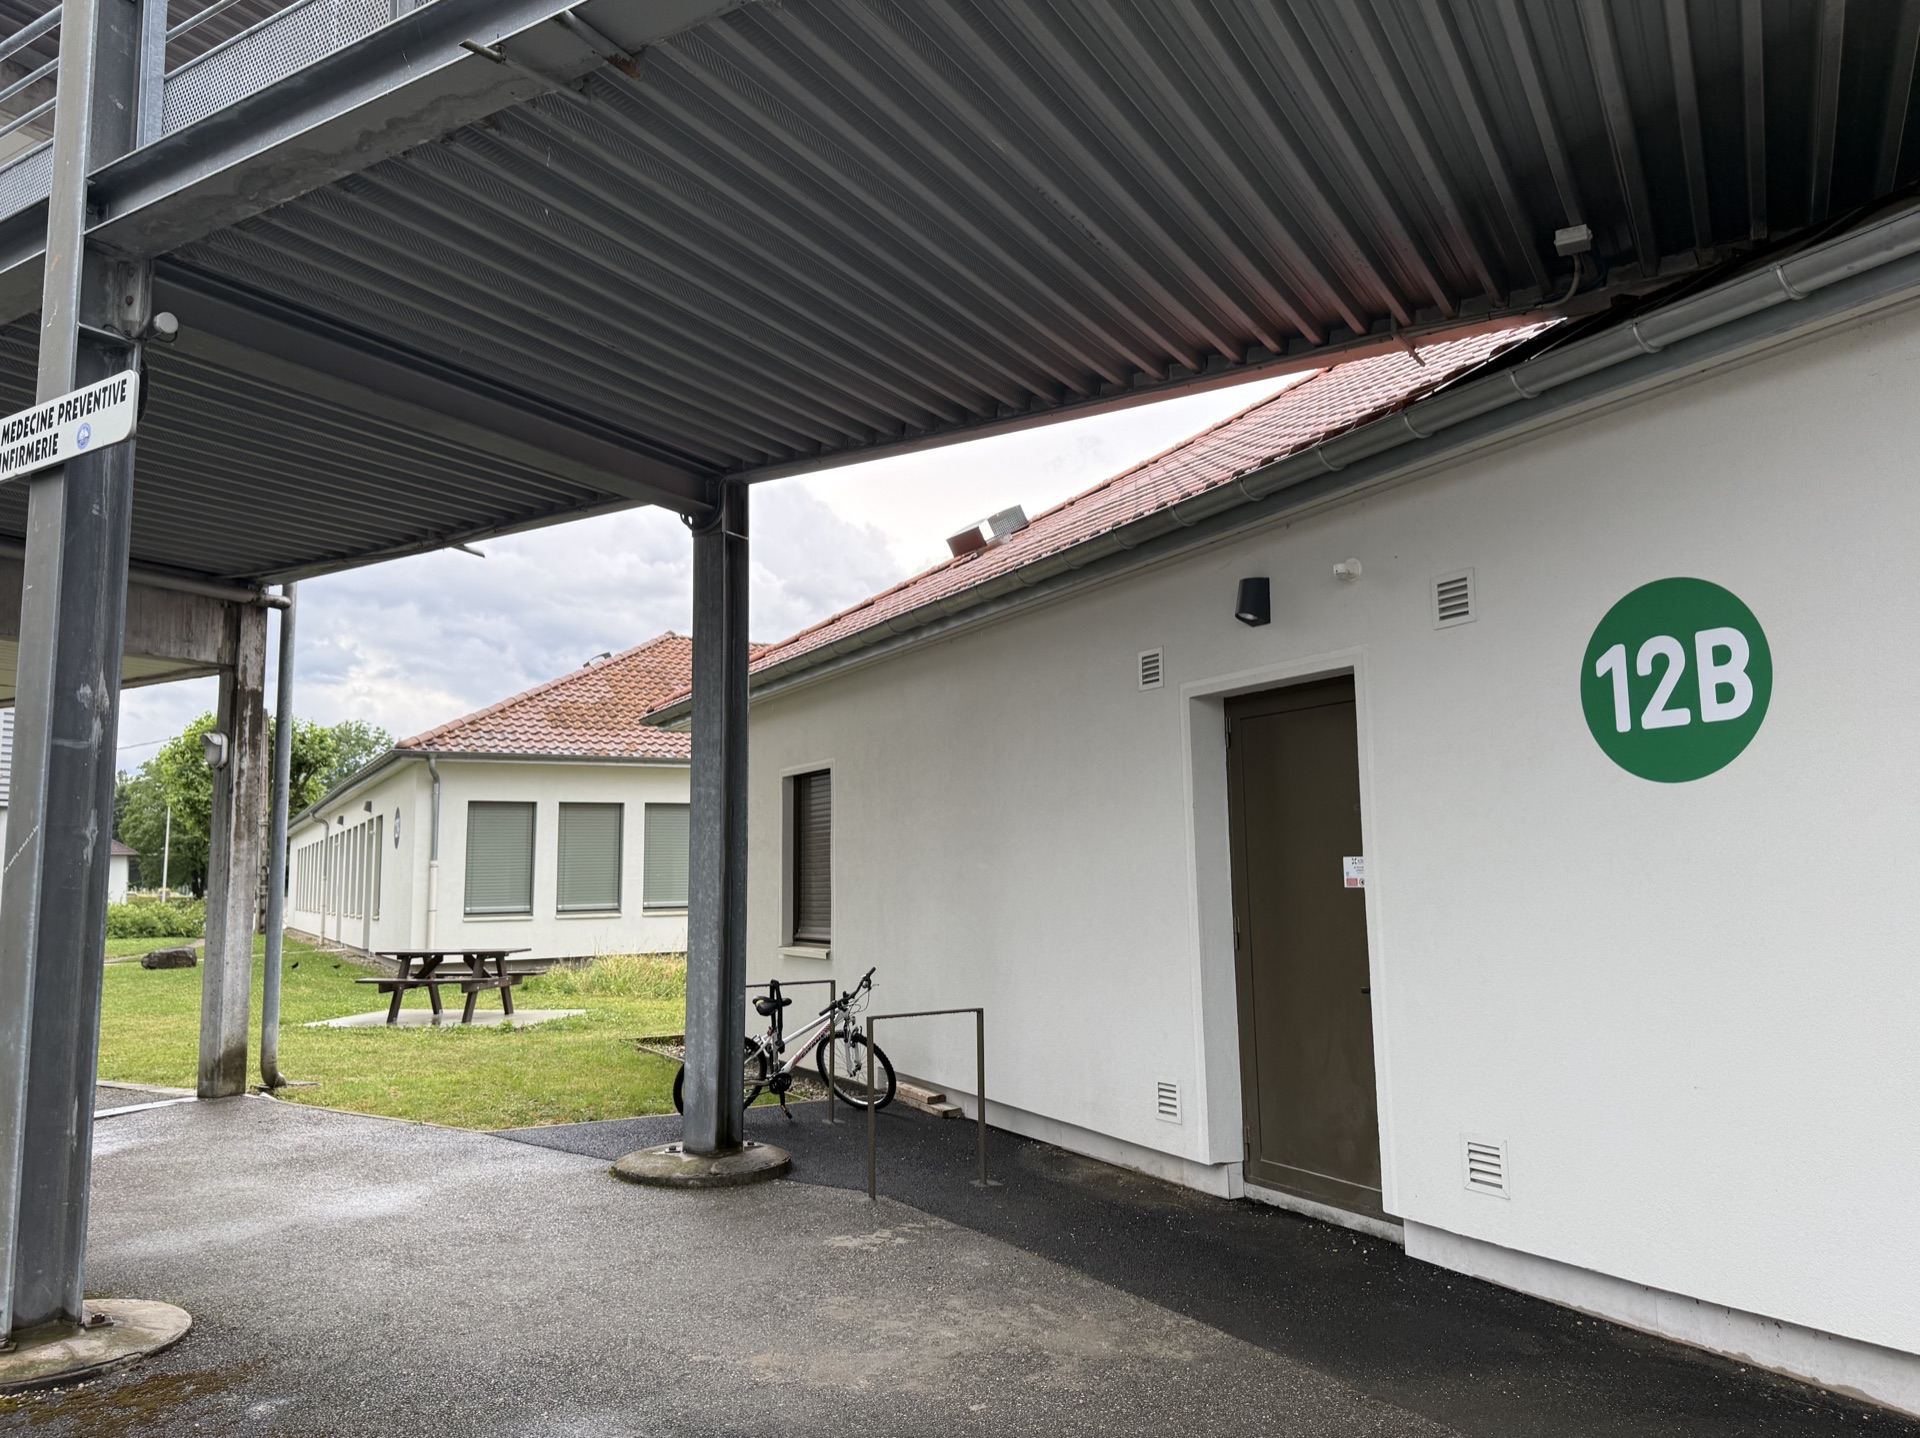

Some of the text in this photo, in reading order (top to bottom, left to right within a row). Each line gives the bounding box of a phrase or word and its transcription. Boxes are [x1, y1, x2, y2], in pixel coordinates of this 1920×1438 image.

[1, 378, 127, 446] MEDECINE PREVENTIVE
[1595, 626, 1754, 733] 12B
